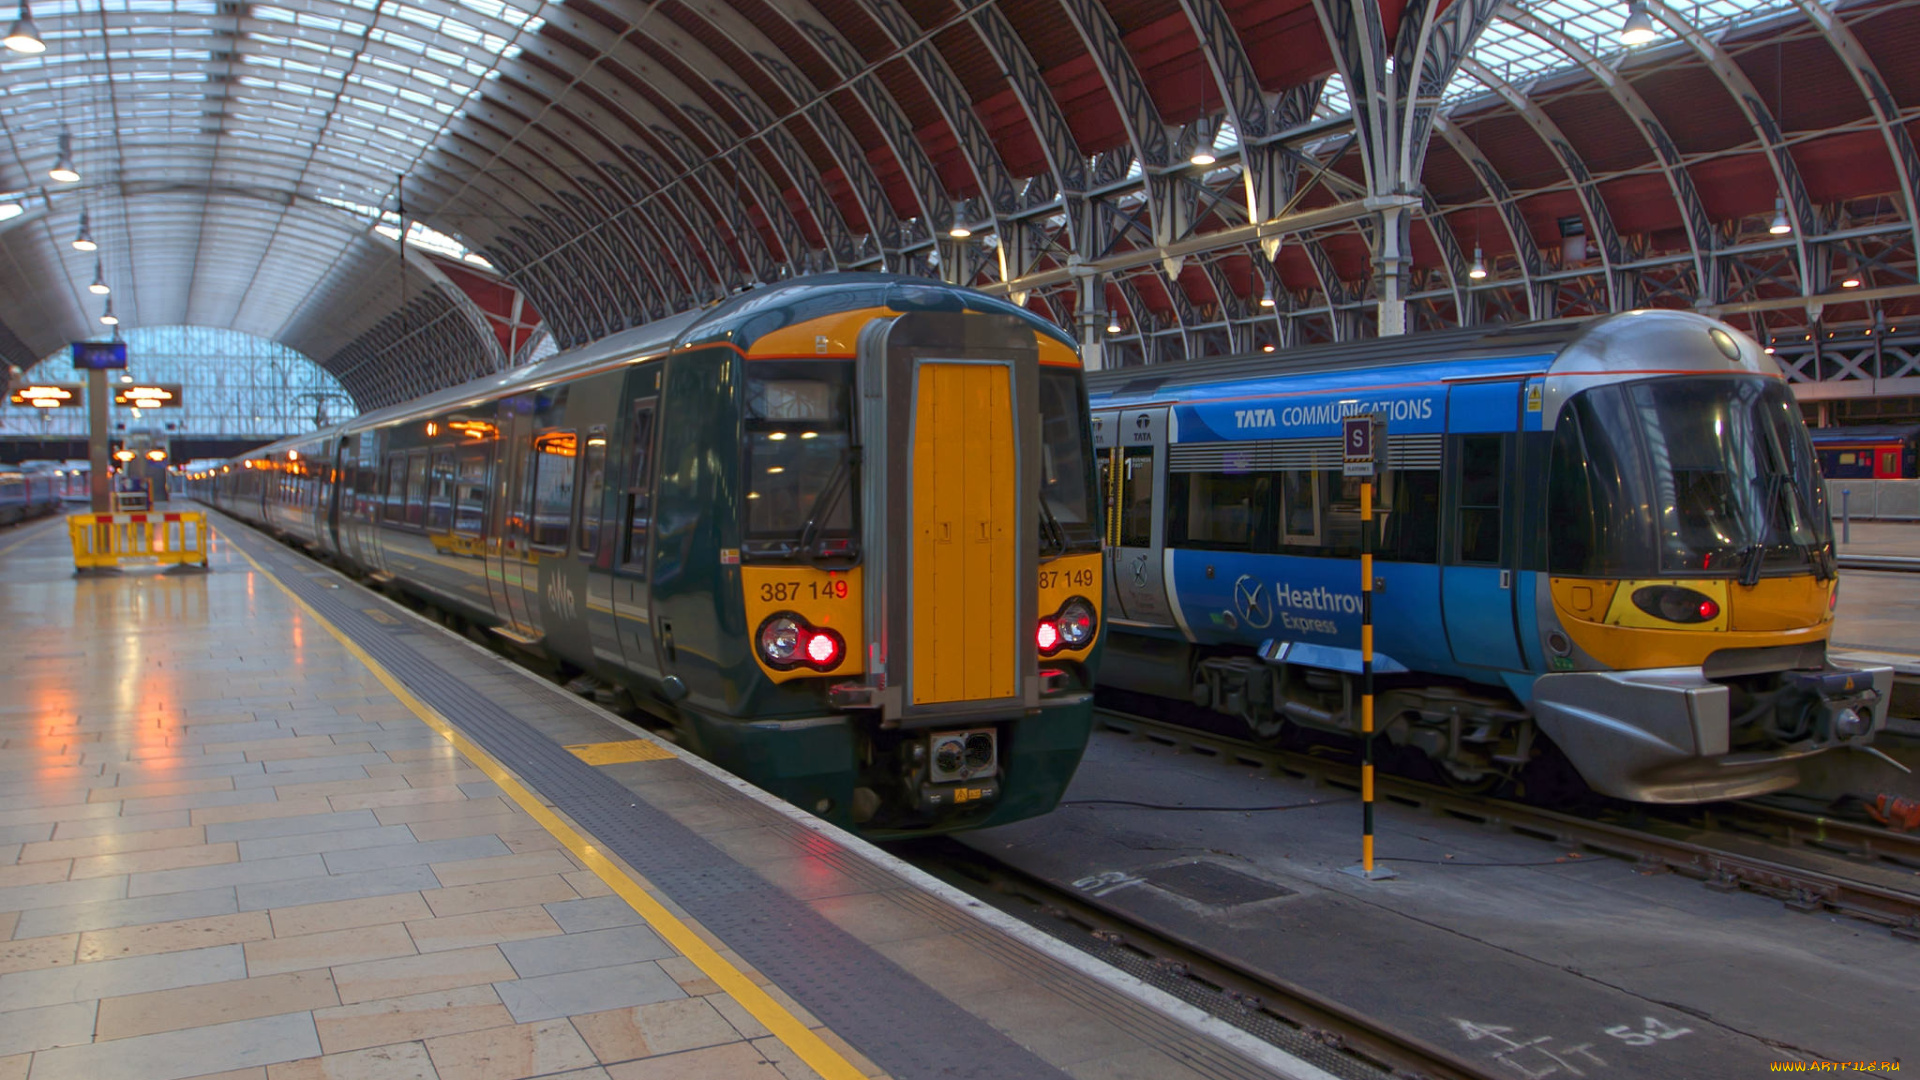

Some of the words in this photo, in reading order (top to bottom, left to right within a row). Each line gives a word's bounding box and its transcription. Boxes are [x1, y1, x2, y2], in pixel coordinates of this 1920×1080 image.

[1235, 409, 1276, 428] TATA
[1133, 432, 1151, 442] TATA
[1352, 429, 1363, 447] S
[1125, 458, 1132, 480] 1
[1038, 571, 1058, 589] 87
[1064, 569, 1093, 588] 149
[760, 582, 800, 602] 387
[808, 580, 848, 600] 149
[1281, 611, 1338, 635] Express
